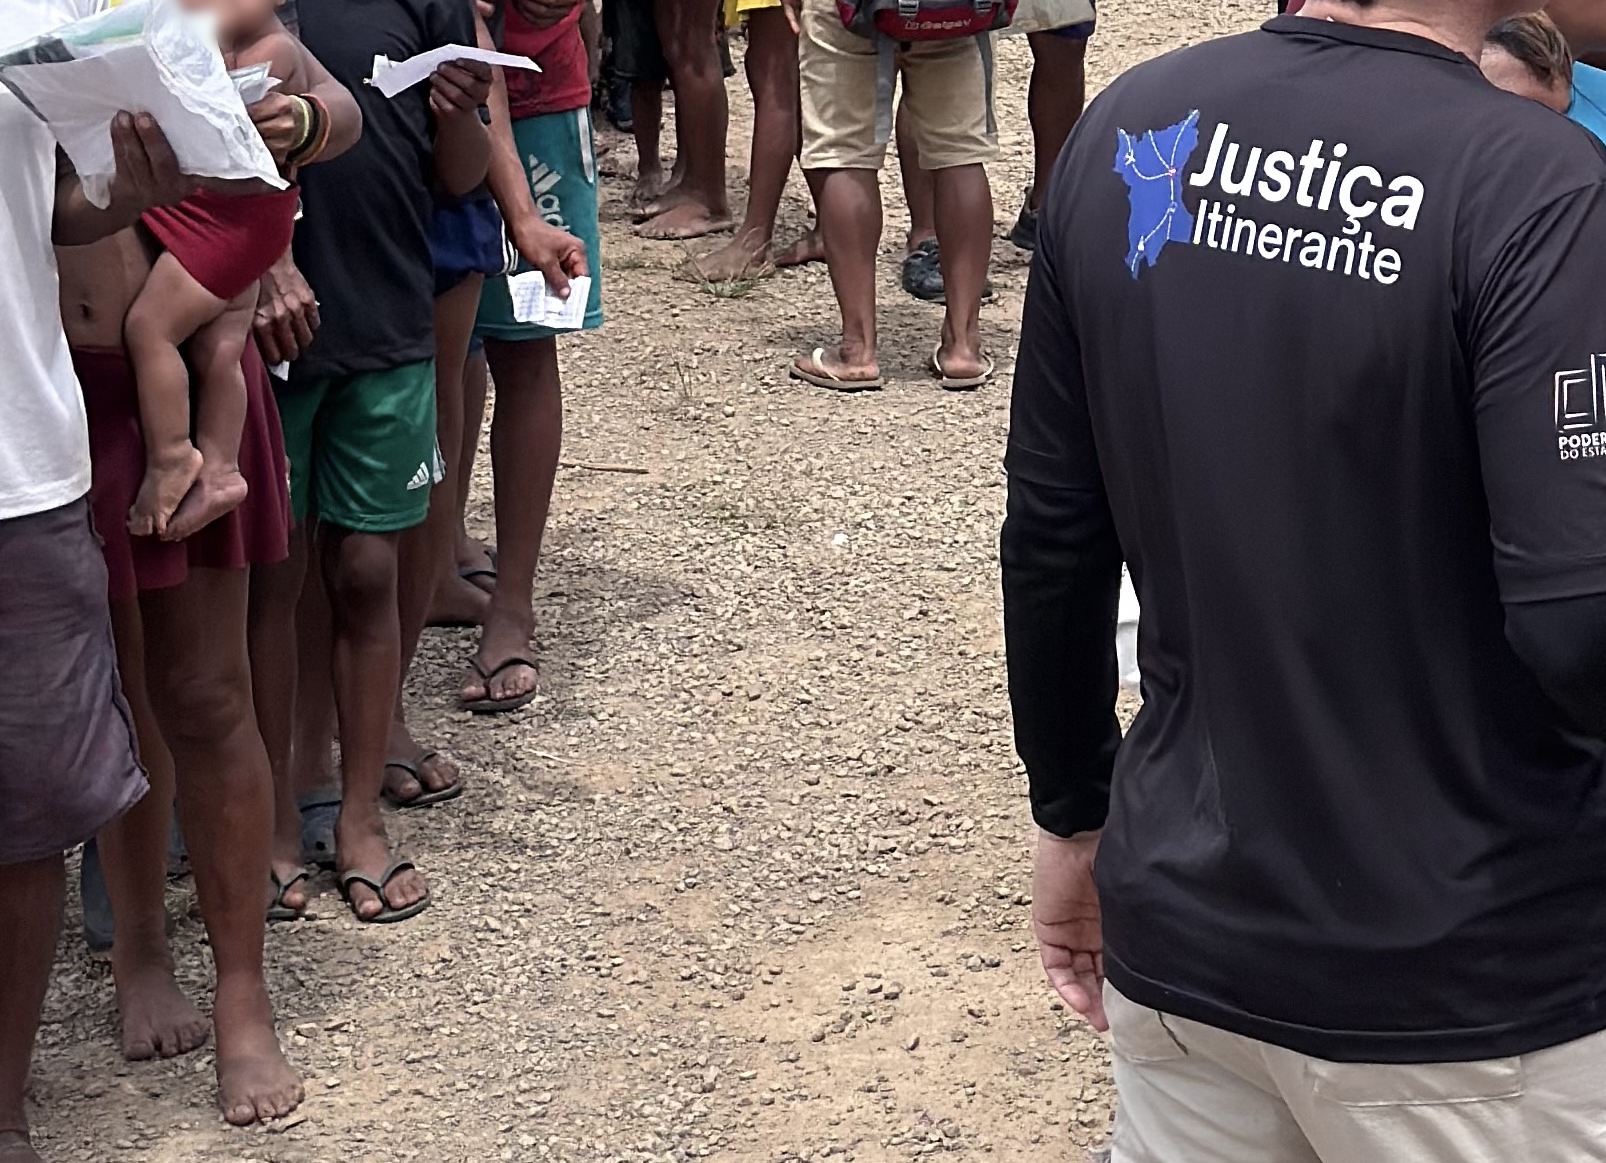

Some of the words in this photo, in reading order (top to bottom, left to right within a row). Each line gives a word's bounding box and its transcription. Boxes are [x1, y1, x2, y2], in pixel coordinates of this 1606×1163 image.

[1190, 123, 1424, 234] Justiça
[1194, 199, 1401, 284] Itinerante
[1560, 449, 1579, 460] DO
